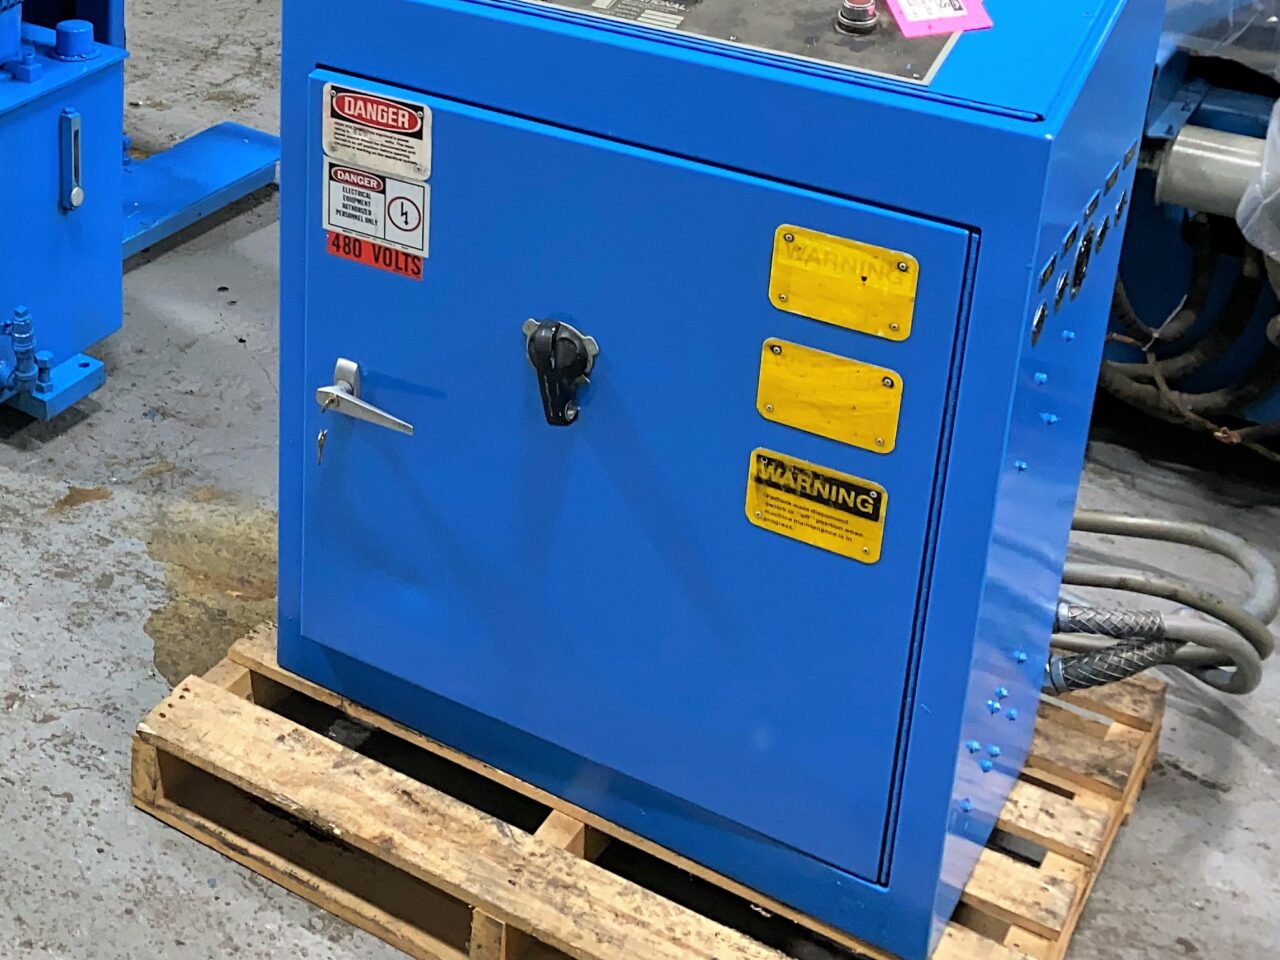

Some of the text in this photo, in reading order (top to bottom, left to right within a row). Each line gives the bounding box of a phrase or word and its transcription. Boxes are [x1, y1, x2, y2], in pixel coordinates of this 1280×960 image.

[344, 96, 409, 129] DANGER
[337, 170, 378, 189] DANGER
[342, 186, 372, 200] ELECTRICAL
[342, 195, 371, 208] EQUIPMENT
[335, 208, 378, 227] PERSONNEL ONLY
[342, 203, 372, 216] AUTHORIZED
[331, 233, 363, 259] 480
[372, 243, 422, 276] VOLTS
[785, 242, 904, 288] WARNING
[759, 461, 875, 515] WARNING
